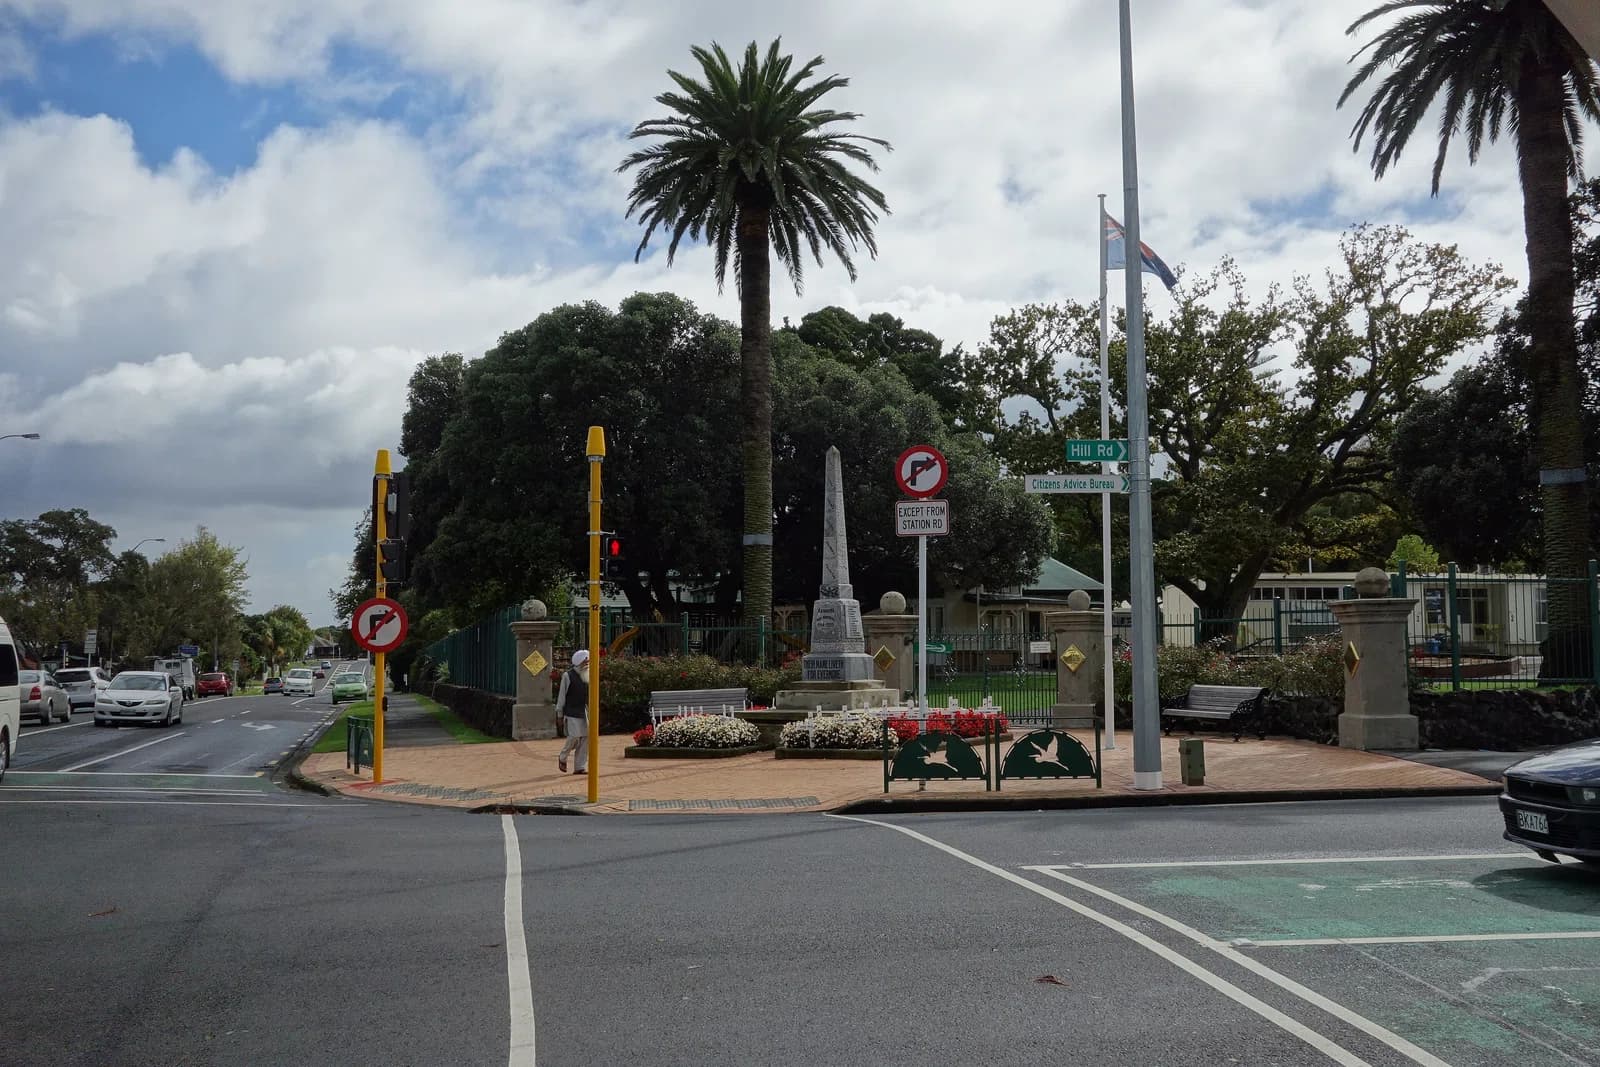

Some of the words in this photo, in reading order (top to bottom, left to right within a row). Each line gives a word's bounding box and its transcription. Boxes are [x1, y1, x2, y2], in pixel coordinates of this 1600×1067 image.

[1071, 444, 1091, 457] Hill
[1097, 444, 1114, 457] Rd
[1032, 479, 1060, 489] Citizens
[1063, 479, 1087, 489] Advice
[1090, 478, 1115, 489] Bureau
[898, 506, 924, 517] EXCEPT
[926, 506, 946, 516] FROM
[902, 519, 931, 530] STATION
[932, 518, 943, 529] RD
